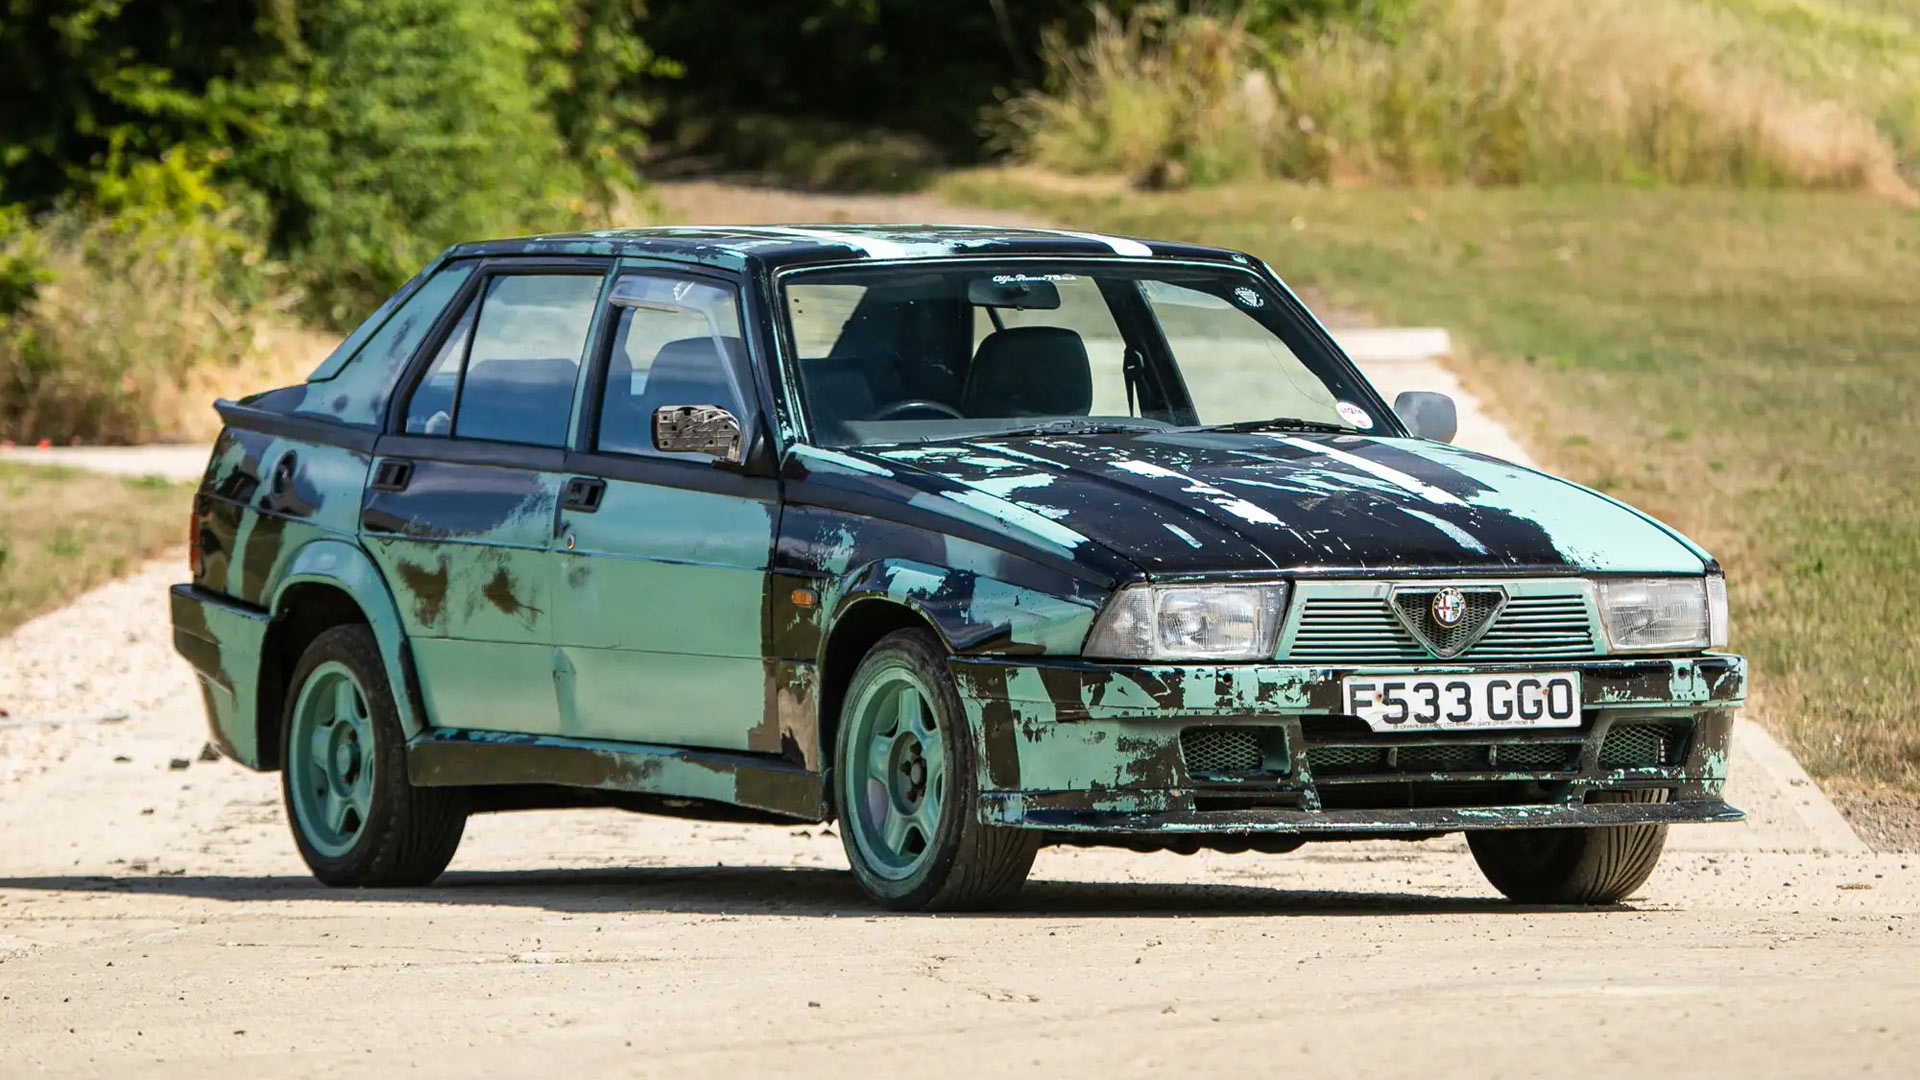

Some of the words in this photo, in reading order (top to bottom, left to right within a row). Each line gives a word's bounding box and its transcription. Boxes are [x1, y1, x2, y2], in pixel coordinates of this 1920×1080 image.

[993, 275, 1015, 285] Alfa
[1350, 681, 1471, 724] F533
[1487, 678, 1573, 721] GGO
